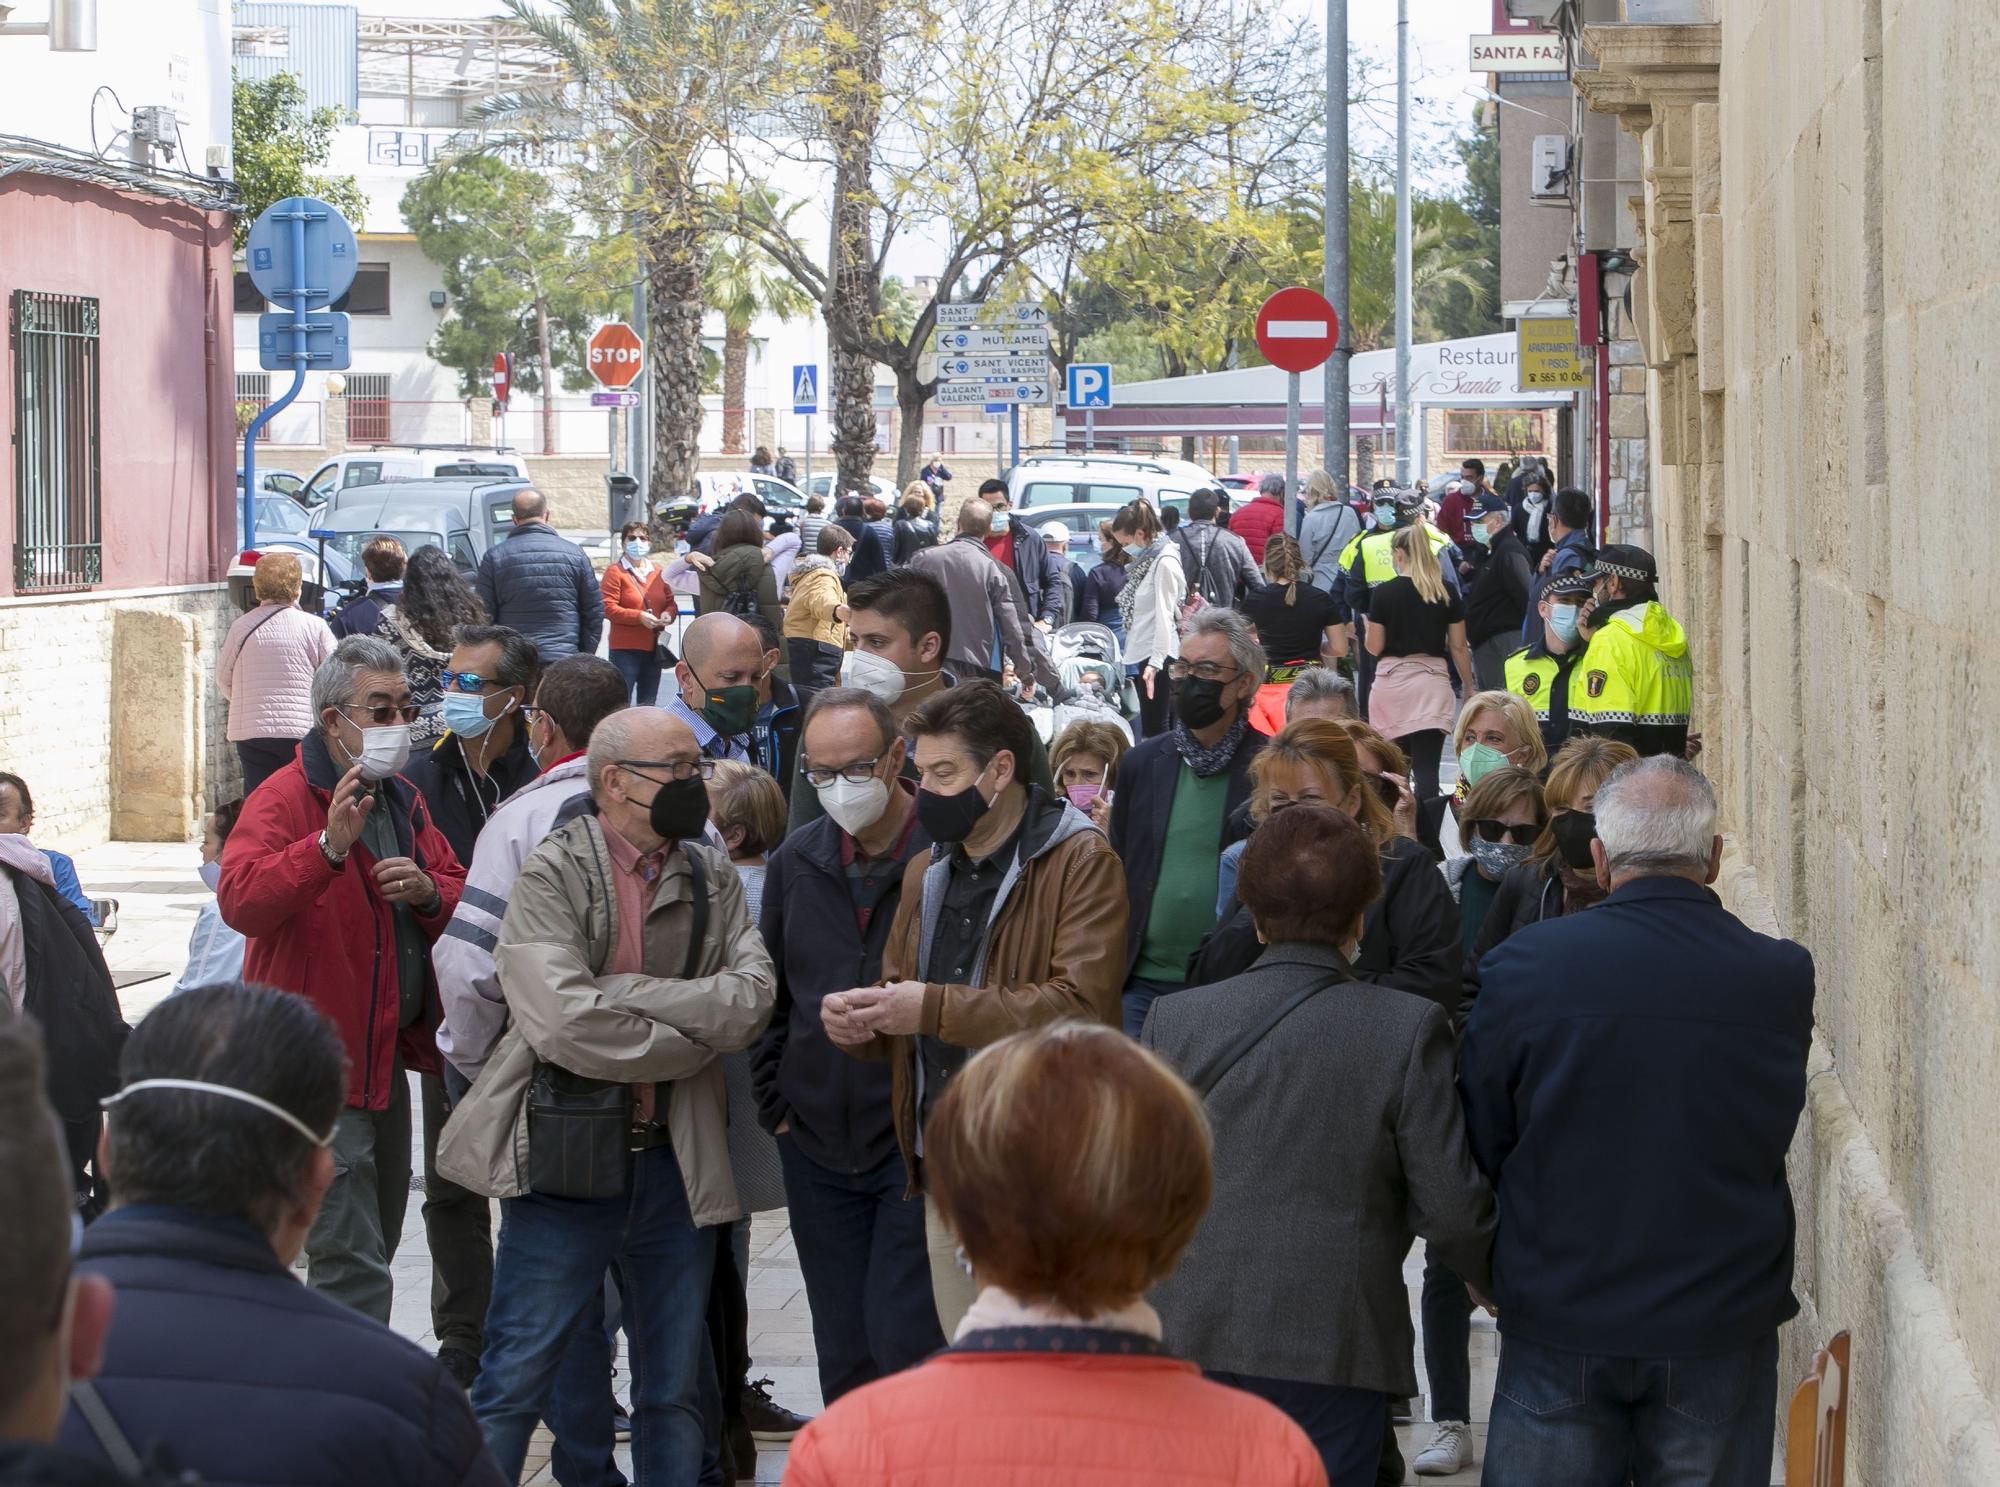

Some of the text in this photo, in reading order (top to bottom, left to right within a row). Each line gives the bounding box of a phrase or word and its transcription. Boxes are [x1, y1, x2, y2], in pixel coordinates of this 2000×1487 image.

[1473, 46, 1527, 60] SANTA
[940, 307, 968, 316] SANT
[591, 347, 641, 363] STOP
[1008, 359, 1045, 367] VICENT
[1540, 372, 1583, 382] 565 10 06
[1075, 369, 1103, 404] P
[1430, 370, 1502, 395] Santa
[941, 386, 983, 394] ALACANT
[941, 394, 986, 402] VALENCIA
